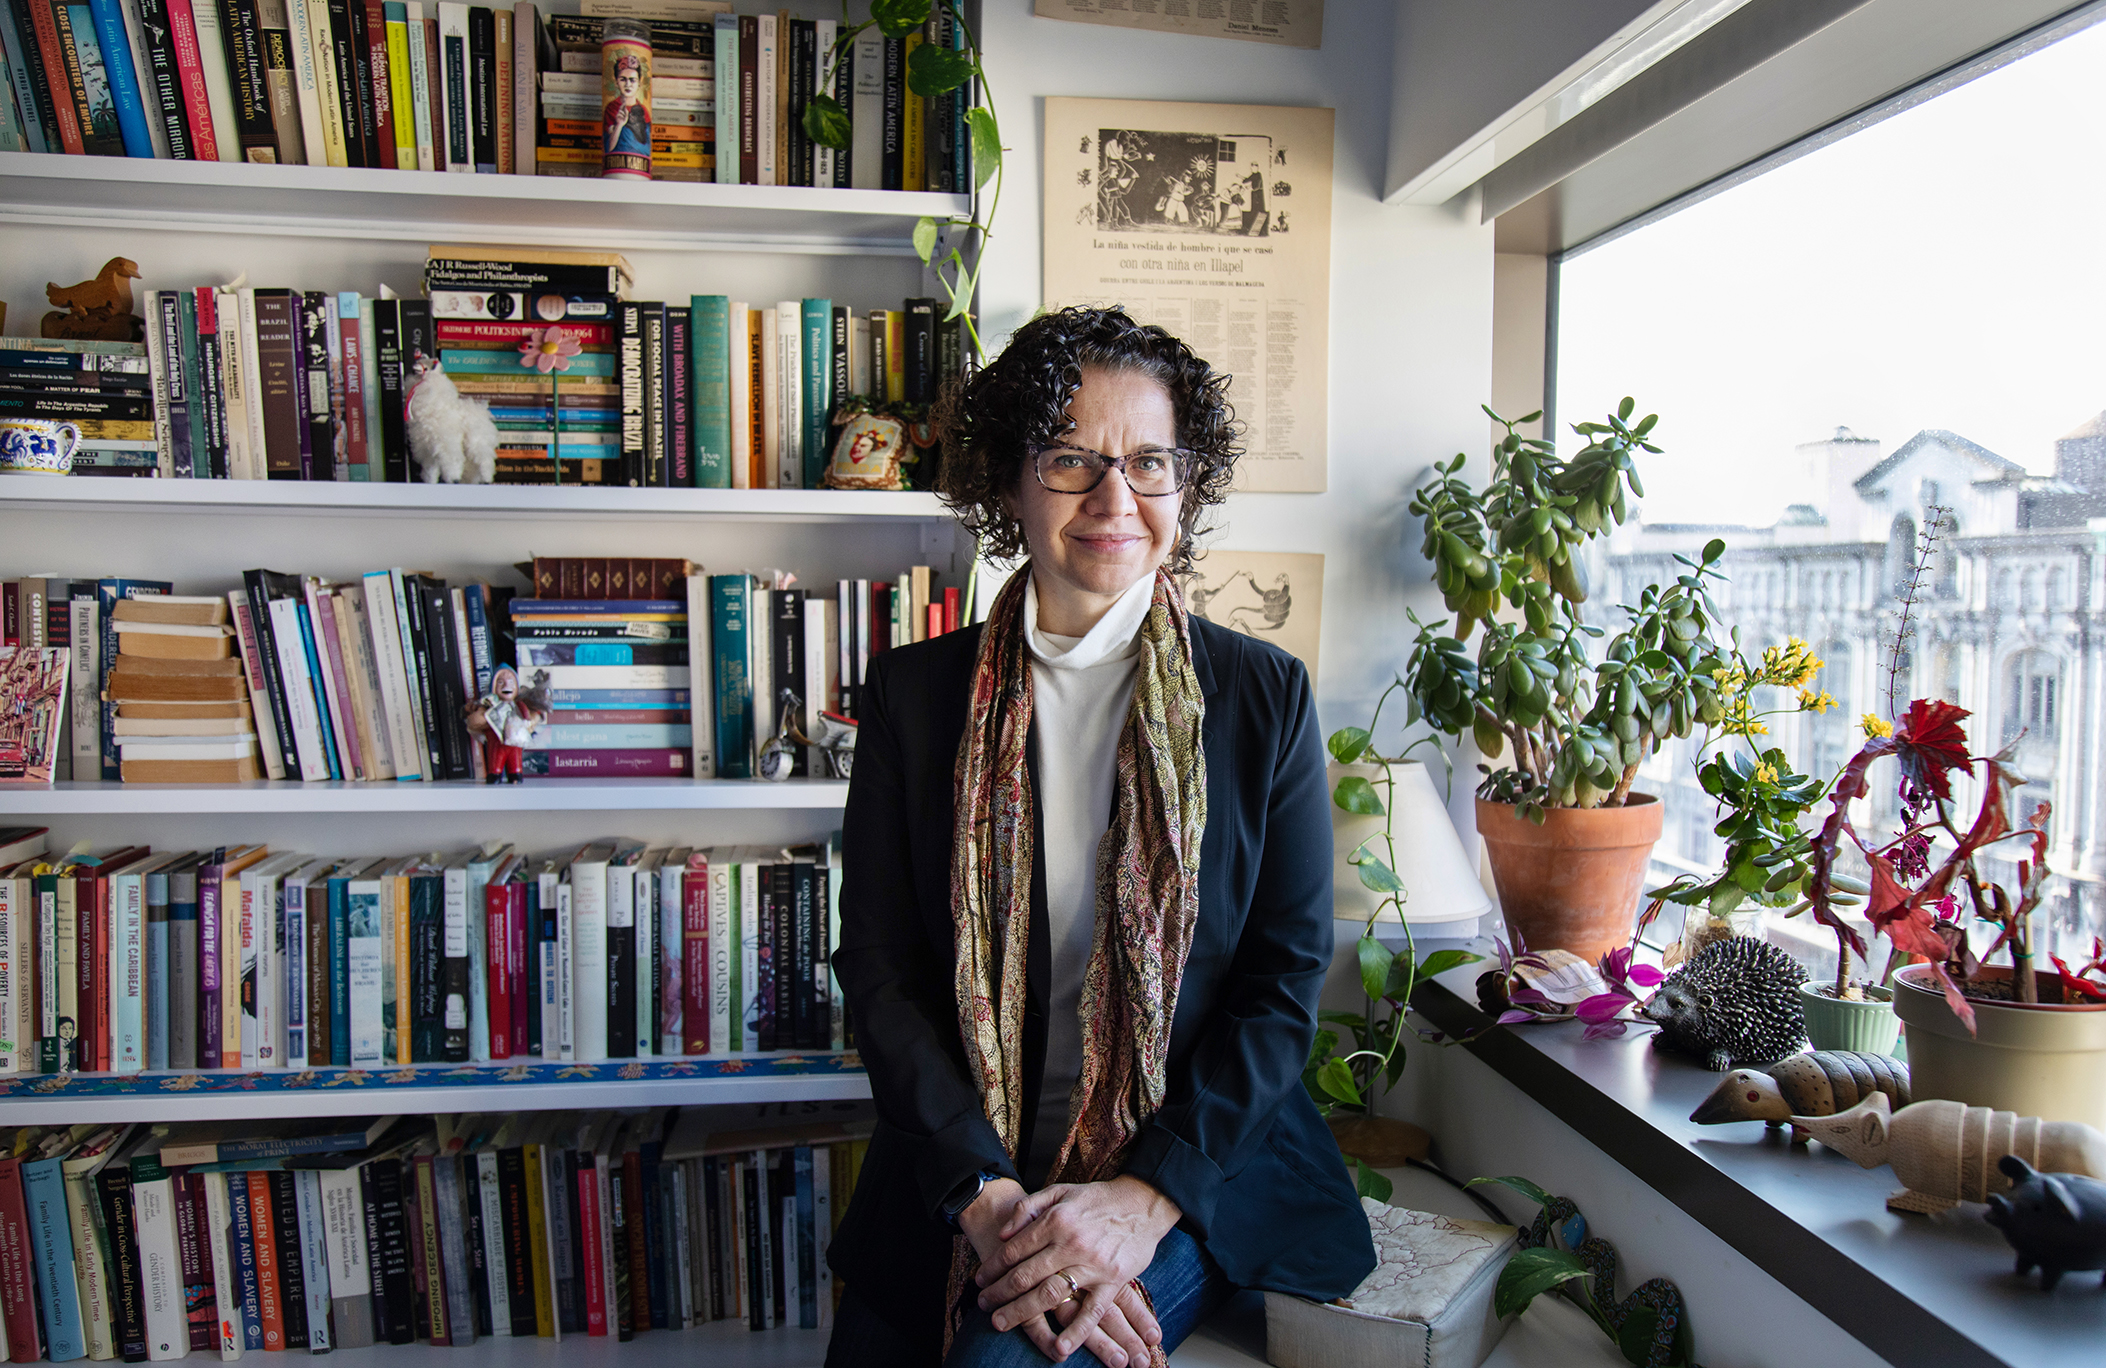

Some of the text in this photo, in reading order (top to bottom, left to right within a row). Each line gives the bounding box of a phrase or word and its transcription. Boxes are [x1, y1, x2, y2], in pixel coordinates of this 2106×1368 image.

[57, 6, 94, 135] CLOSE ENCOUNTERS OF EMPIRE
[105, 19, 132, 110] Latin American Law
[233, 31, 248, 78] AMERICAN
[241, 82, 255, 121] HISTORY
[242, 10, 265, 113] The Oxford Handbook of
[17, 68, 35, 122] HYBRID CULTURES
[153, 48, 186, 159] THE OTHER MIRROR
[190, 72, 212, 141] Américas
[358, 59, 372, 136] Afro-Latin America
[480, 84, 488, 123] International
[501, 61, 510, 118] DEFINING
[886, 39, 898, 153] MODERN LATIN AMERICA
[502, 123, 511, 174] NATIONS
[607, 155, 649, 171] FRIDA KAHLO
[1093, 239, 1104, 248] La
[1108, 241, 1128, 249] niña
[1133, 242, 1164, 250] vestida
[1167, 242, 1177, 251] de
[1181, 242, 1215, 253] hombre
[1224, 246, 1241, 255] que
[1255, 245, 1273, 254] casó
[1120, 258, 1243, 275] con otra niña en Illapel
[431, 271, 466, 280] Fidalgos
[484, 272, 548, 283] Philanthropists
[836, 317, 844, 345] STEIN
[206, 342, 220, 448] INSURGENT CITIZENSHIP
[622, 338, 641, 414] DEMOCRATIZING
[653, 320, 663, 460] FOR SOCIAL PEACE IN BRAZIL
[752, 334, 761, 455] SLAVE REBELLION IN BRAZIL
[673, 324, 686, 478] WITH BROADAX AND FIREBRAND
[854, 421, 895, 436] VIVA
[835, 462, 882, 474] FRIDA
[552, 690, 581, 702] allejo
[556, 730, 607, 743] blest gana
[555, 756, 598, 767] lastarria
[128, 885, 138, 917] FAMILY
[242, 891, 252, 948] Mafalda
[82, 911, 90, 940] FAMILY
[128, 930, 138, 945] THE
[715, 873, 728, 1015] CAPTIVES COUSINS
[1, 951, 7, 959] OF
[82, 942, 90, 960] AND
[781, 905, 789, 1019] COLONIAL HABITS
[128, 948, 138, 997] CARIBBEAN
[611, 982, 620, 1006] Secrets
[40, 1201, 48, 1224] Family
[114, 1197, 125, 1222] Gender
[214, 1211, 222, 1245] FAMILIES
[46, 1248, 54, 1261] the
[182, 1236, 191, 1275] PERSPECTIVE
[187, 1200, 199, 1274] WOMEN'S HISTORY
[217, 1246, 223, 1255] OF
[280, 1172, 301, 1302] AUNTED BY EMPIRE
[12, 1247, 20, 1260] Life
[16, 1280, 24, 1302] Long
[76, 1248, 85, 1280] 1500-1789
[86, 1251, 94, 1273] Early
[118, 1234, 131, 1284] Cross-Cultural
[236, 1195, 257, 1319] WOMEN AND SLAVERY
[255, 1196, 275, 1320] WOMEN AND SLAVERY
[48, 1262, 60, 1297] Twentieth
[88, 1272, 97, 1299] Modern
[150, 1253, 164, 1313] GENDER HISTORY
[220, 1281, 228, 1309] WORLD
[425, 1222, 442, 1335] IMPOSING DECENCY
[54, 1299, 62, 1326] Century
[92, 1300, 100, 1322] Times
[123, 1286, 135, 1324] Perspective
